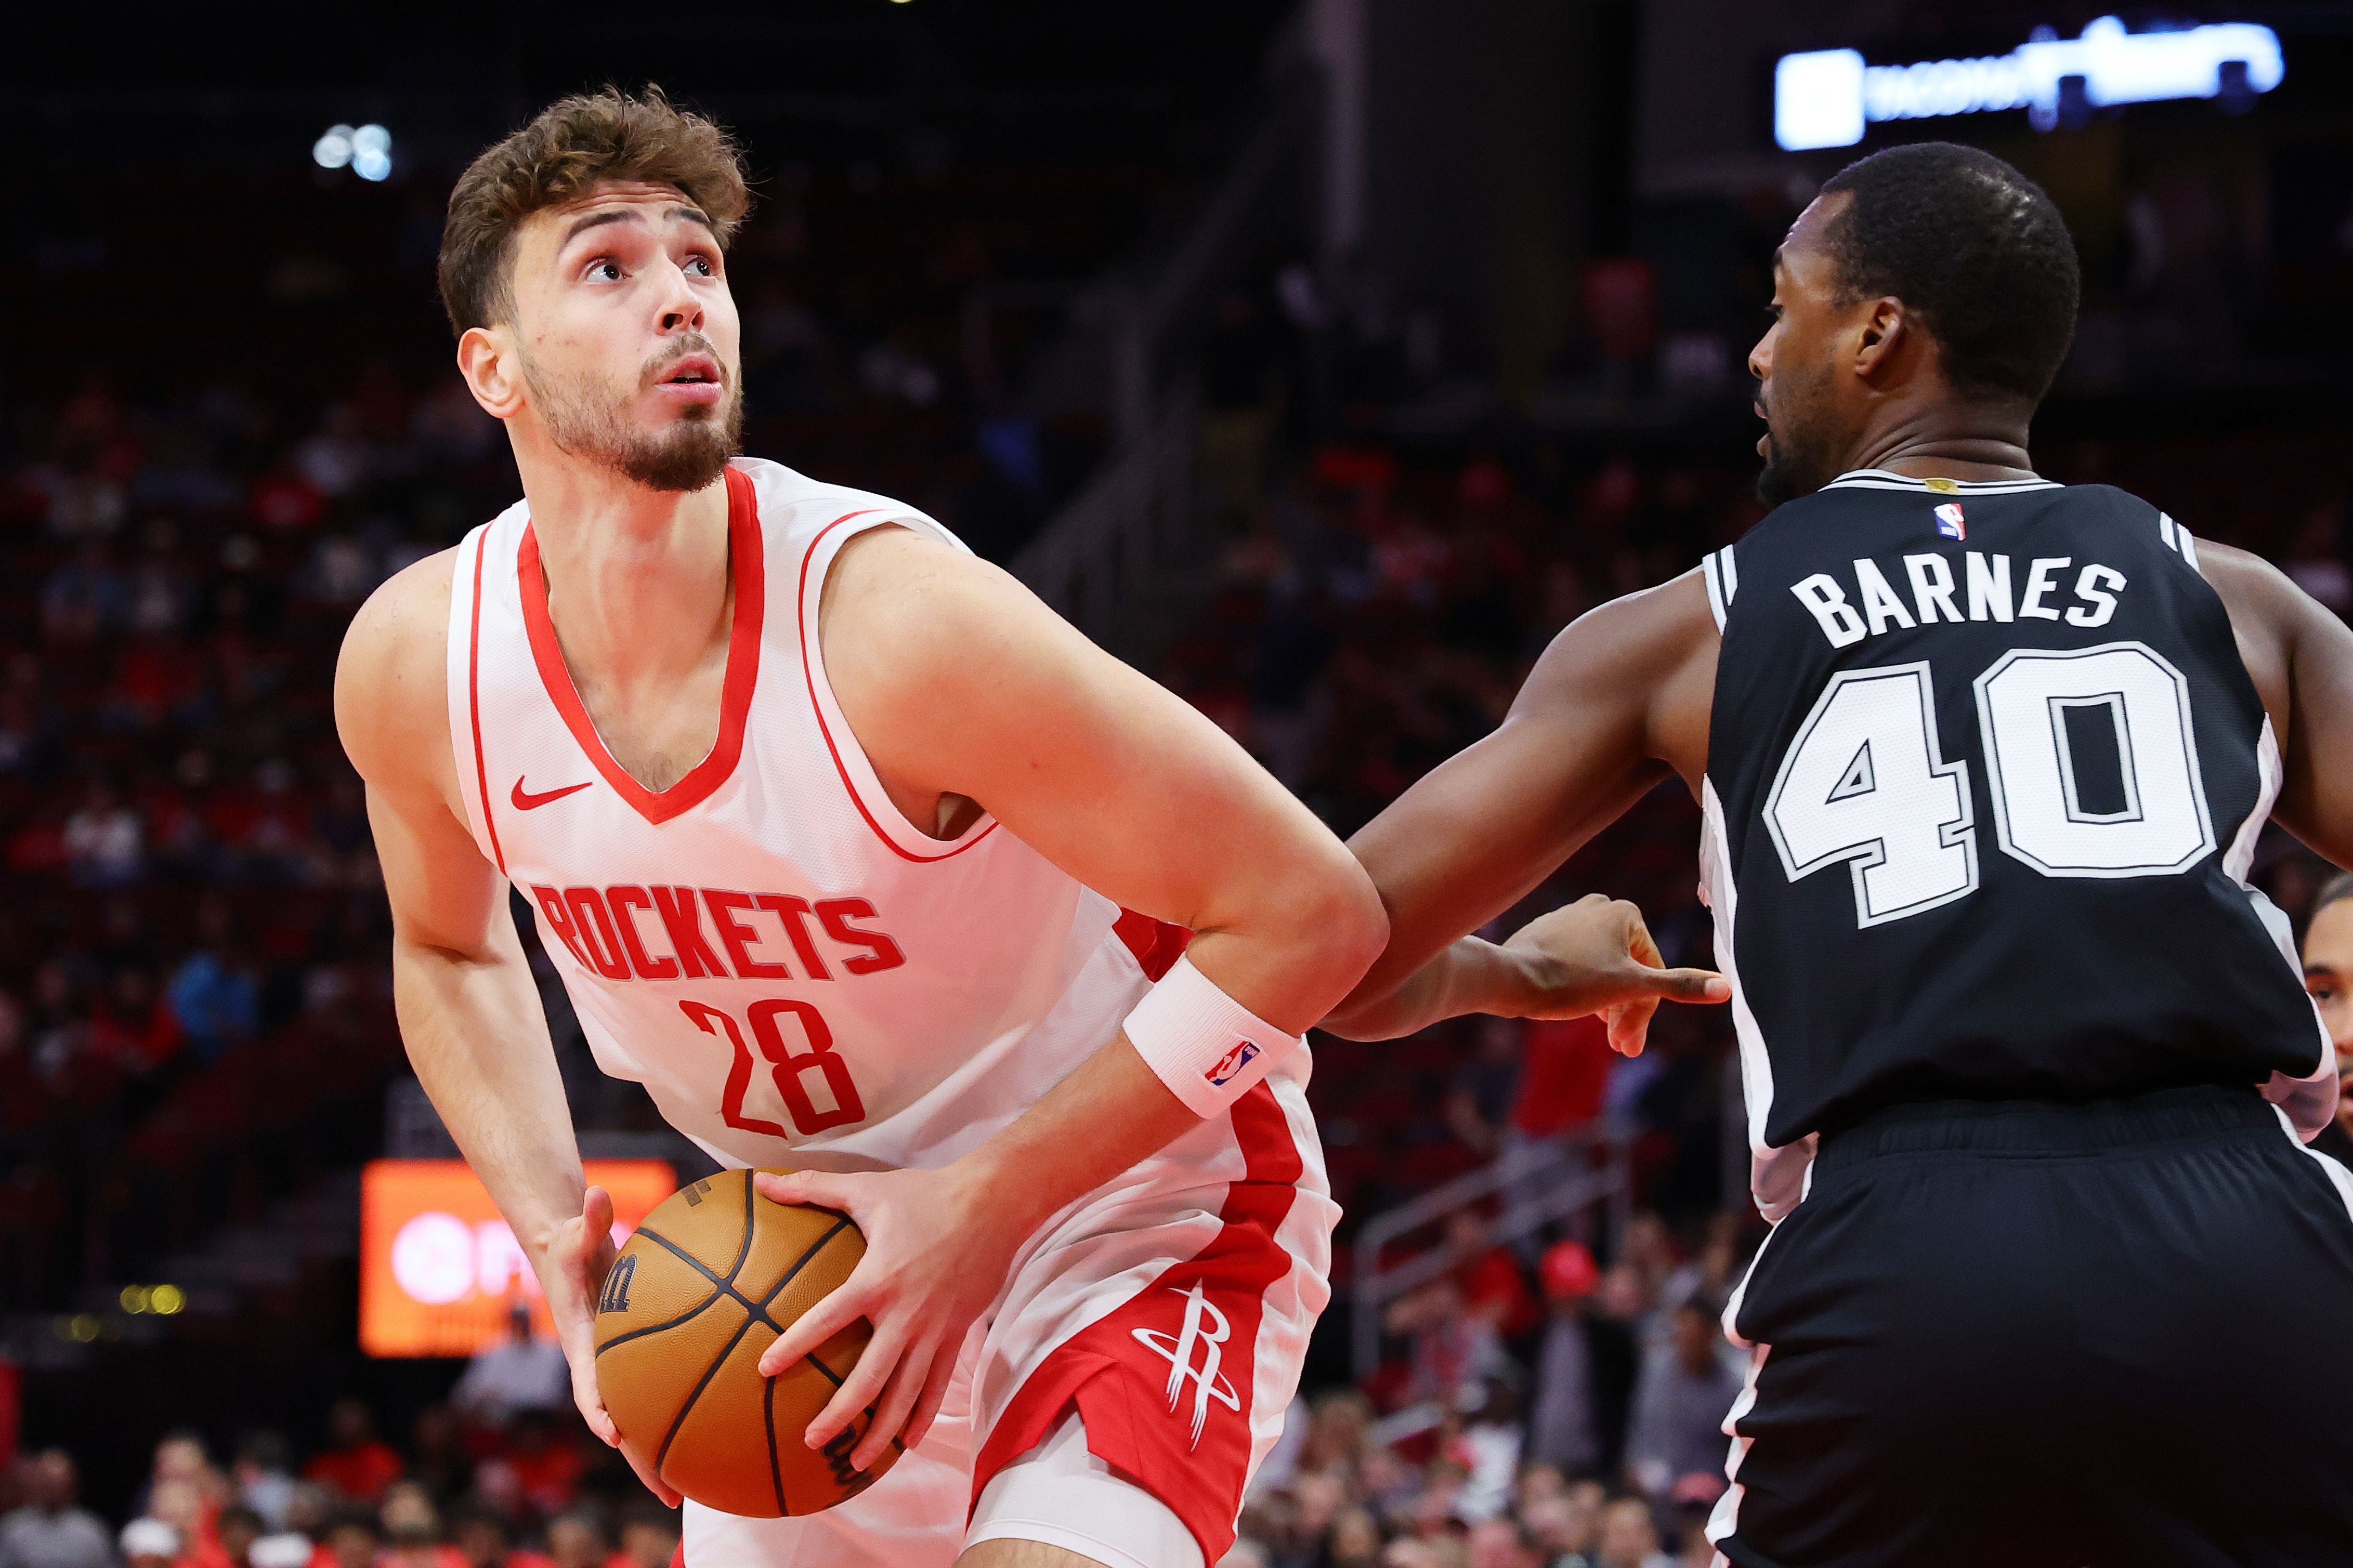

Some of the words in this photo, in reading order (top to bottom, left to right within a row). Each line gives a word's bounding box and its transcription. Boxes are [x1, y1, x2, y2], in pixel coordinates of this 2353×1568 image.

[1789, 551, 2127, 649] BARNES
[1762, 640, 2218, 929] 40
[529, 883, 907, 981] ROCKETS
[679, 998, 866, 1140] 28
